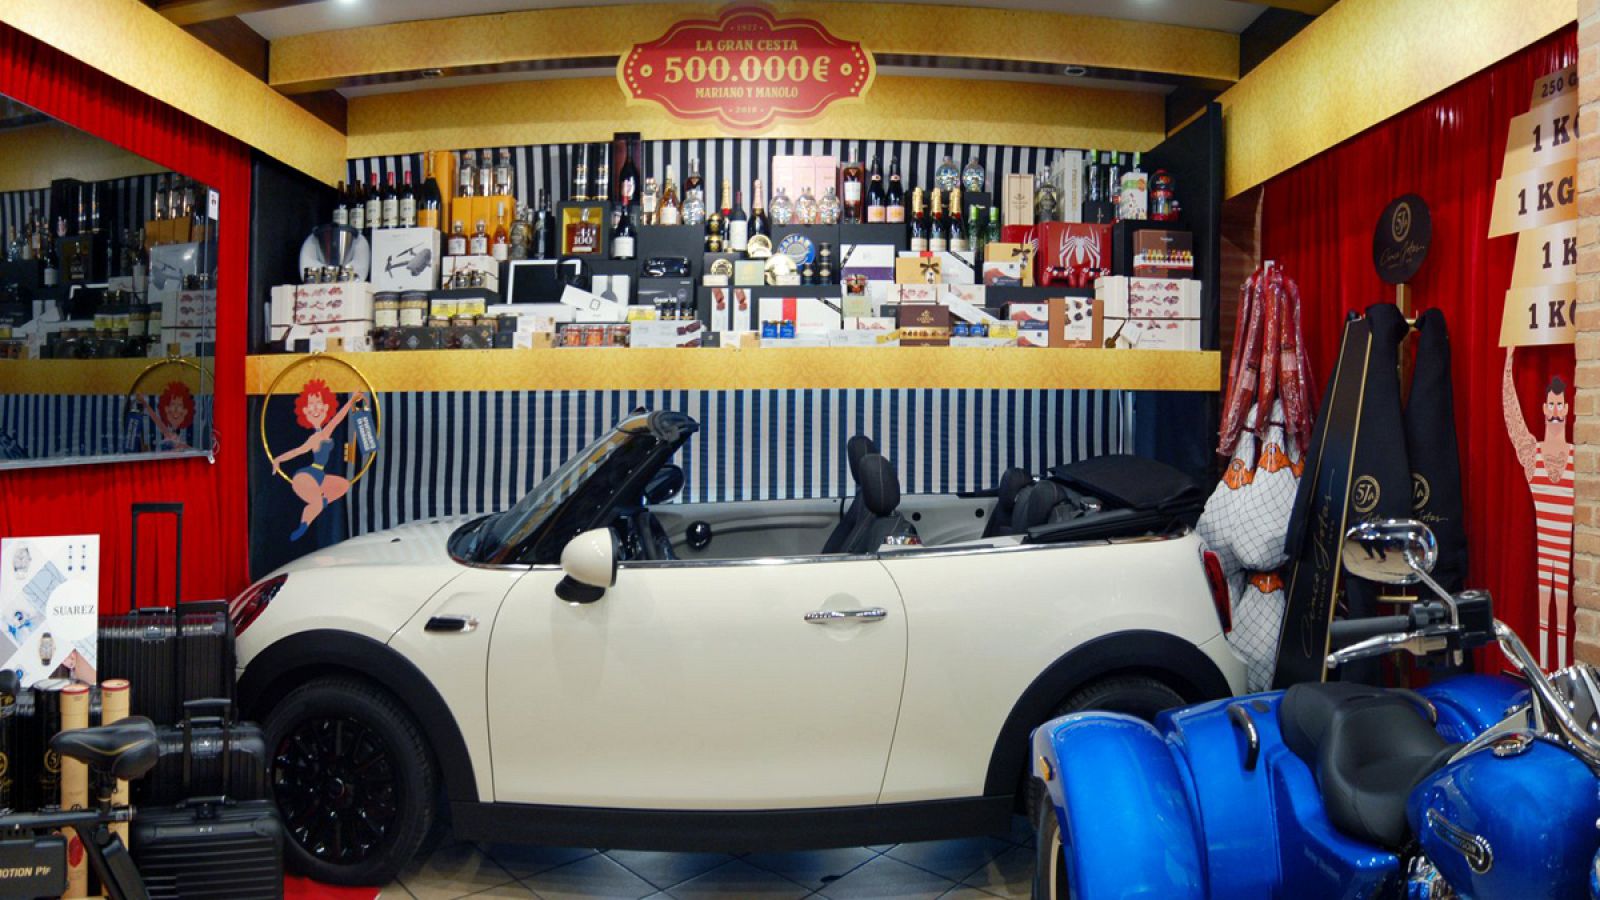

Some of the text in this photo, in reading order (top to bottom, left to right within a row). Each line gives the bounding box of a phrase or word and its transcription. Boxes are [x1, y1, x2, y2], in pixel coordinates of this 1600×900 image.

[696, 39, 799, 51] LA GRAN CESTA
[664, 56, 831, 84] 500.000€
[695, 87, 799, 98] MARIANO Y MANOLO
[1542, 78, 1564, 98] 250
[1532, 125, 1543, 152] 1
[1518, 176, 1575, 216] 1 KG
[1542, 241, 1552, 269] 1
[1528, 303, 1539, 329] 1
[53, 605, 95, 616] SUAREZ
[0, 867, 33, 878] OTION
